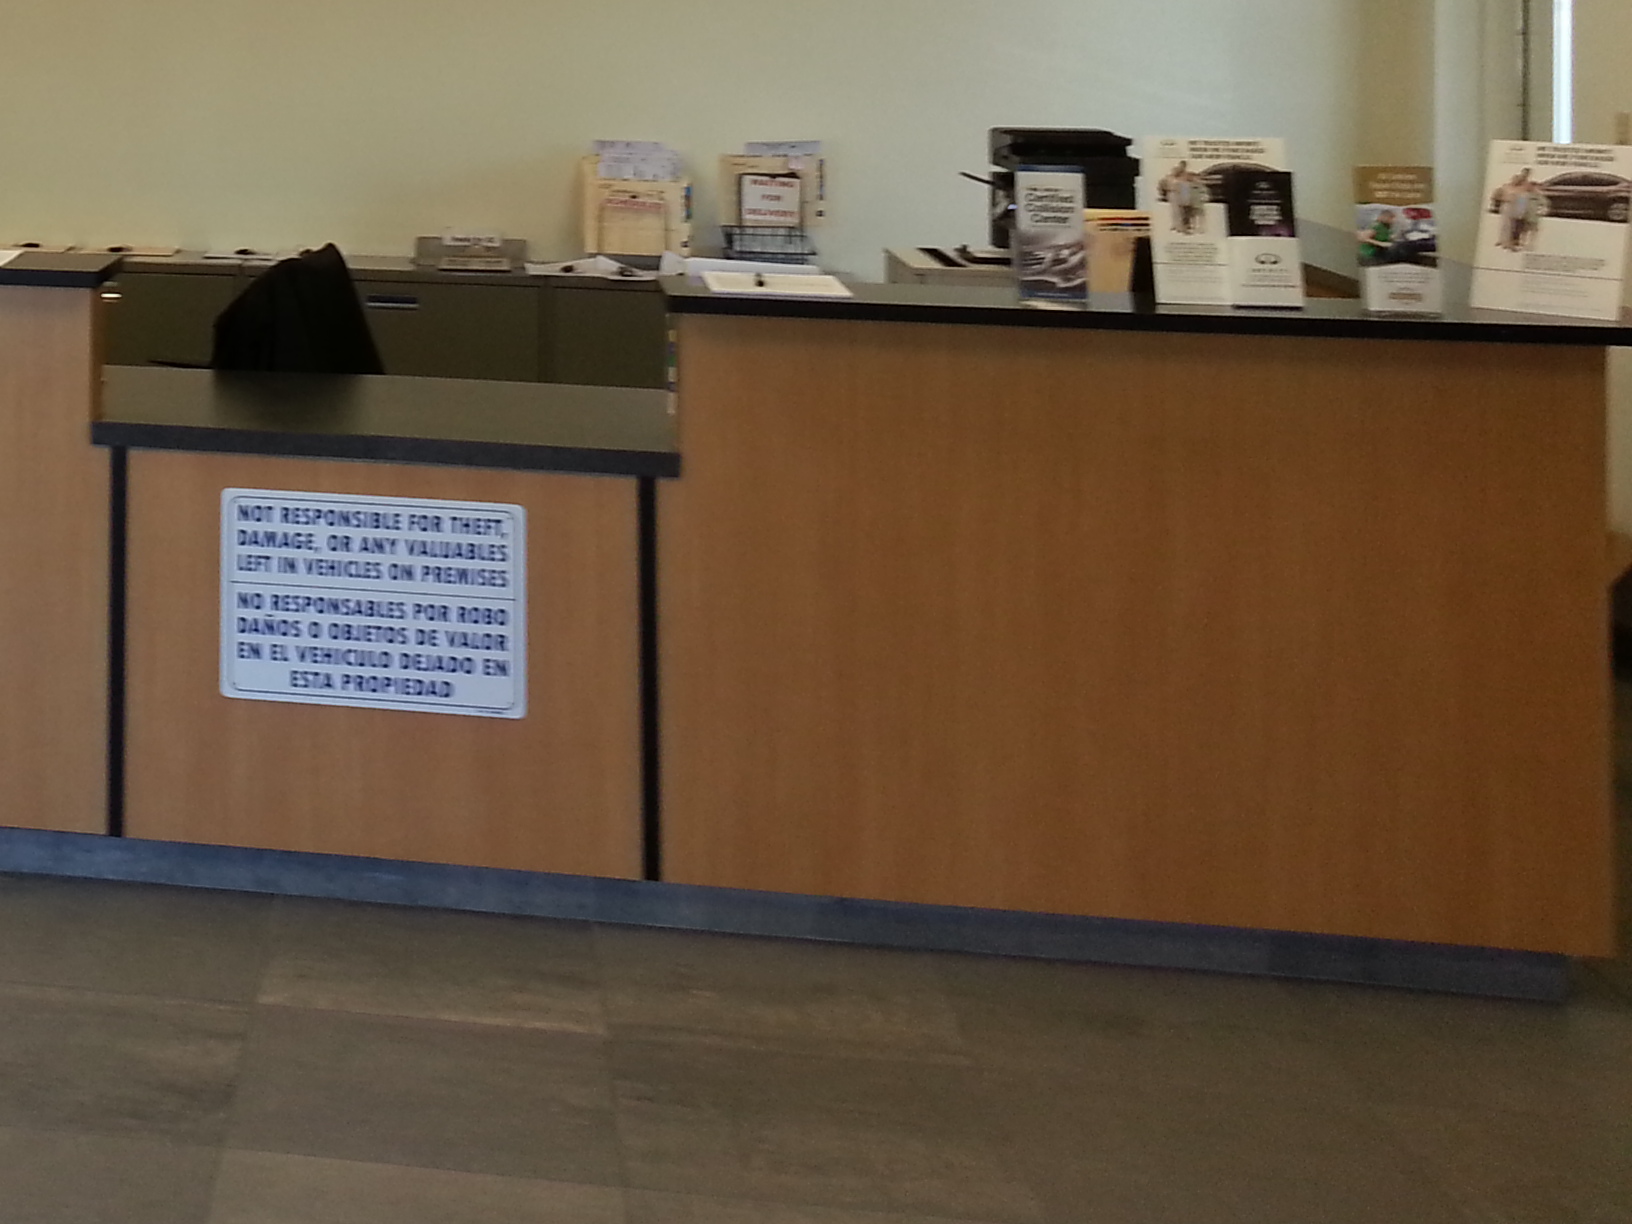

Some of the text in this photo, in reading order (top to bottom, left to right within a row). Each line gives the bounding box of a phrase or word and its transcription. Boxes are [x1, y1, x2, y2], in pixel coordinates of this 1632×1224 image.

[237, 504, 273, 523] NOT
[279, 507, 402, 531] RESPONSIBLE
[408, 513, 443, 533] FOR
[326, 534, 350, 552] OR
[358, 536, 397, 556] ANY
[405, 539, 508, 562] VALUABLES
[236, 554, 509, 588] LEFT IN VEHICLES ON PREMISES
[237, 591, 509, 626] NO RESPONSABLES POR ROBO
[237, 614, 508, 651] DAÑOS O OBJETOS DE VALOR
[237, 641, 510, 677] EN EL VEHICULO DEJADO EN
[289, 670, 456, 699] ESTA PROPIEDAD
